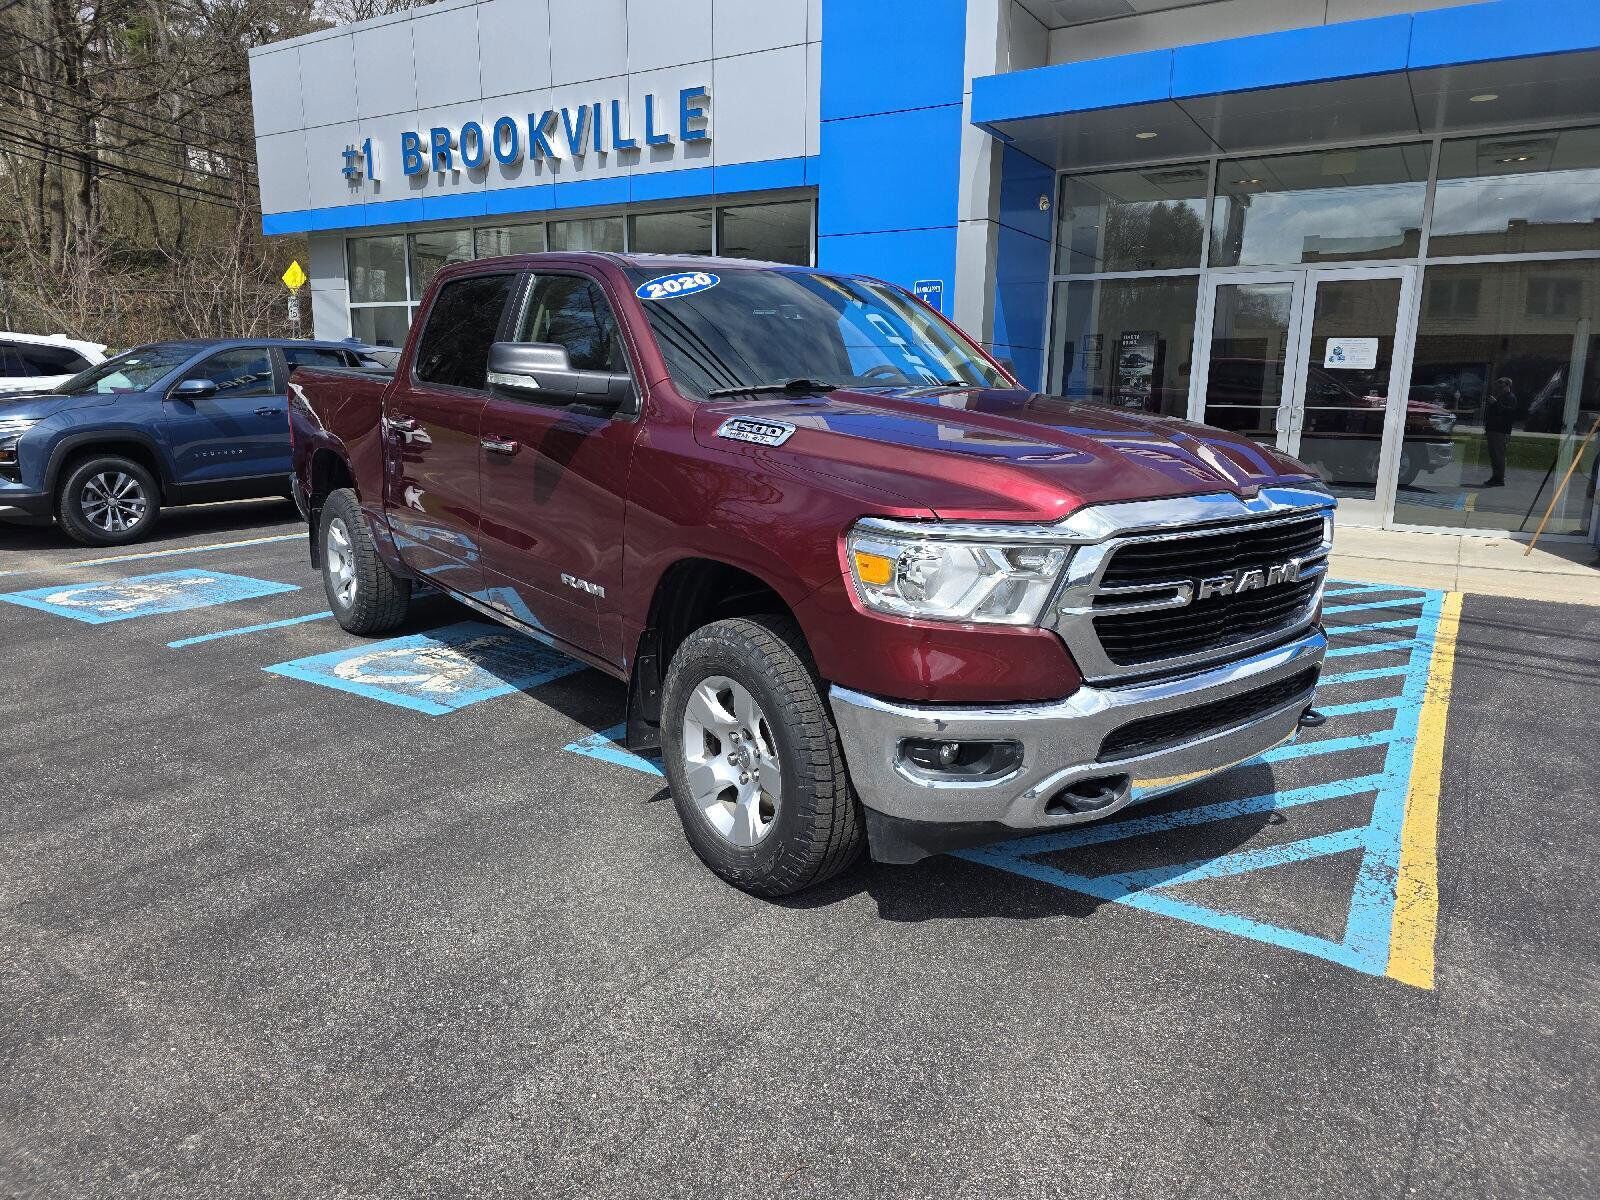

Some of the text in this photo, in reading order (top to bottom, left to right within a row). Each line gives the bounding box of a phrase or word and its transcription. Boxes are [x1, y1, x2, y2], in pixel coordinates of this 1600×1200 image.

[341, 85, 710, 181] #1 BROOKVILLE
[646, 272, 712, 299] 2020
[560, 573, 605, 599] RAM
[1198, 558, 1300, 601] RAM
